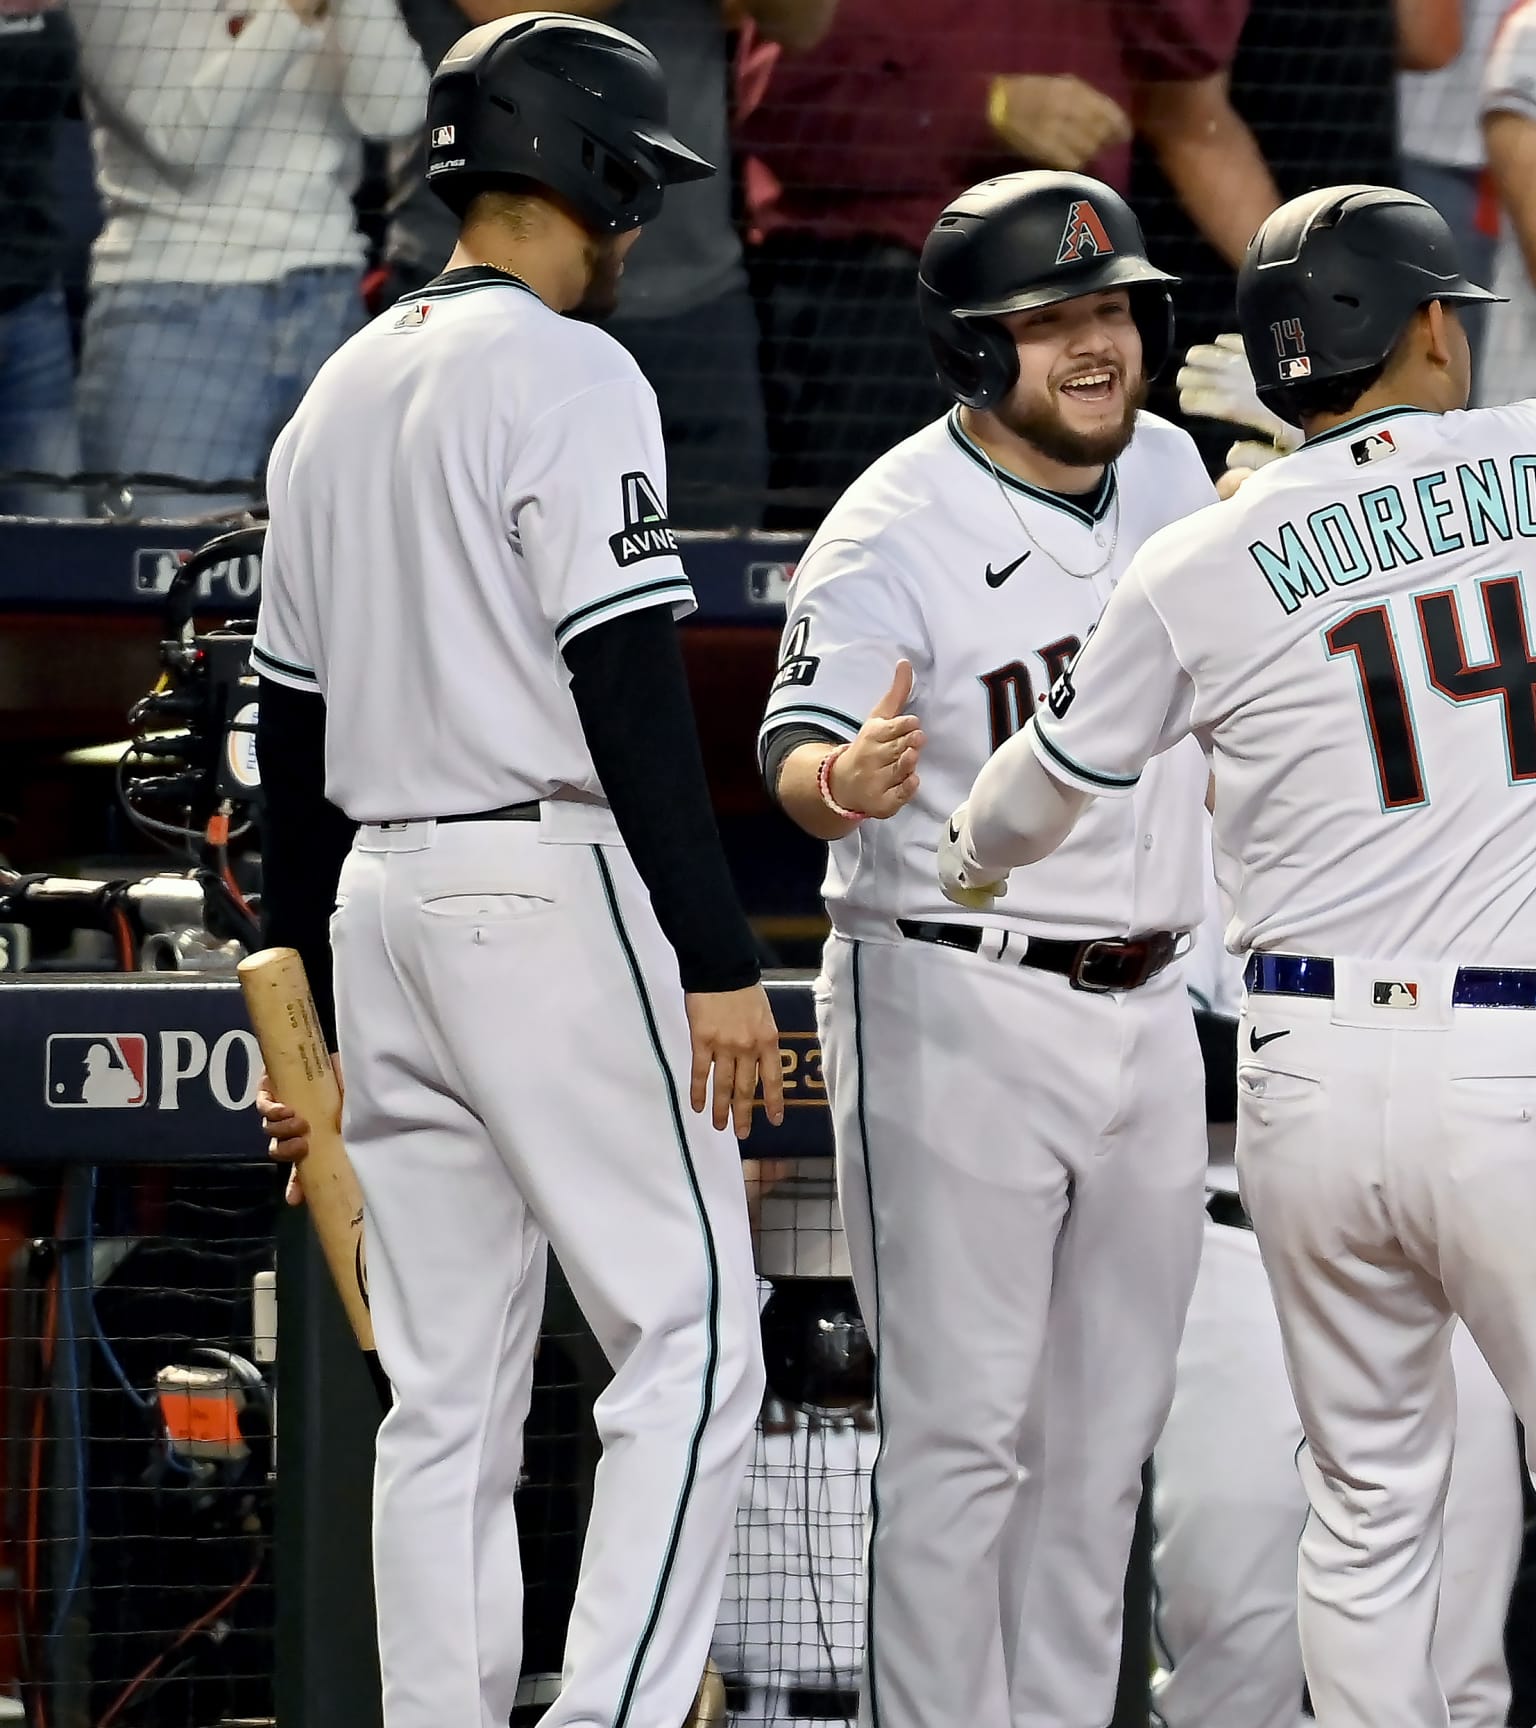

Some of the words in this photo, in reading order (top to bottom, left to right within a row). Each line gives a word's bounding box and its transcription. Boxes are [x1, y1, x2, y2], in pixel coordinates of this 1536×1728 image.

[1055, 200, 1115, 264] A
[1270, 317, 1306, 357] 14
[159, 1029, 263, 1111] PO
